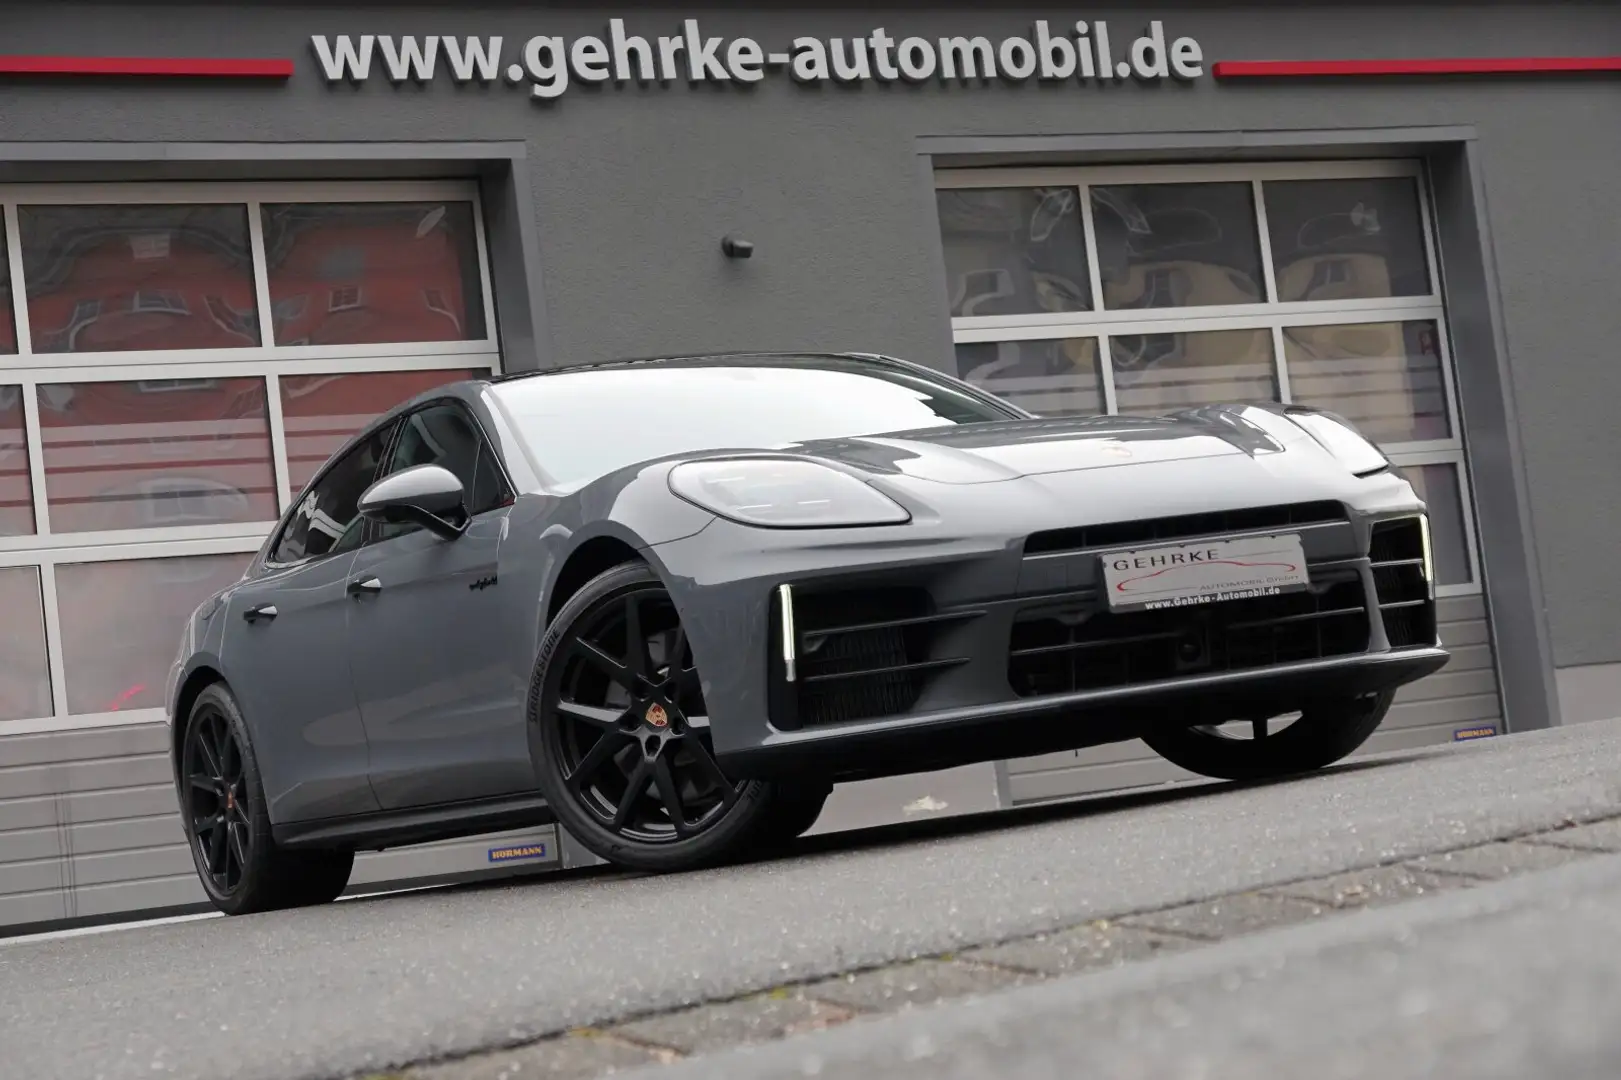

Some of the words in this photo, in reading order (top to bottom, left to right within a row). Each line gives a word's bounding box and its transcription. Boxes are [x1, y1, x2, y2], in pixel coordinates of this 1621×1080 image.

[310, 17, 1204, 98] www.gehrke-automobil.de
[1113, 548, 1220, 571] GEHRKE
[1199, 577, 1265, 592] AUTOMOBIL
